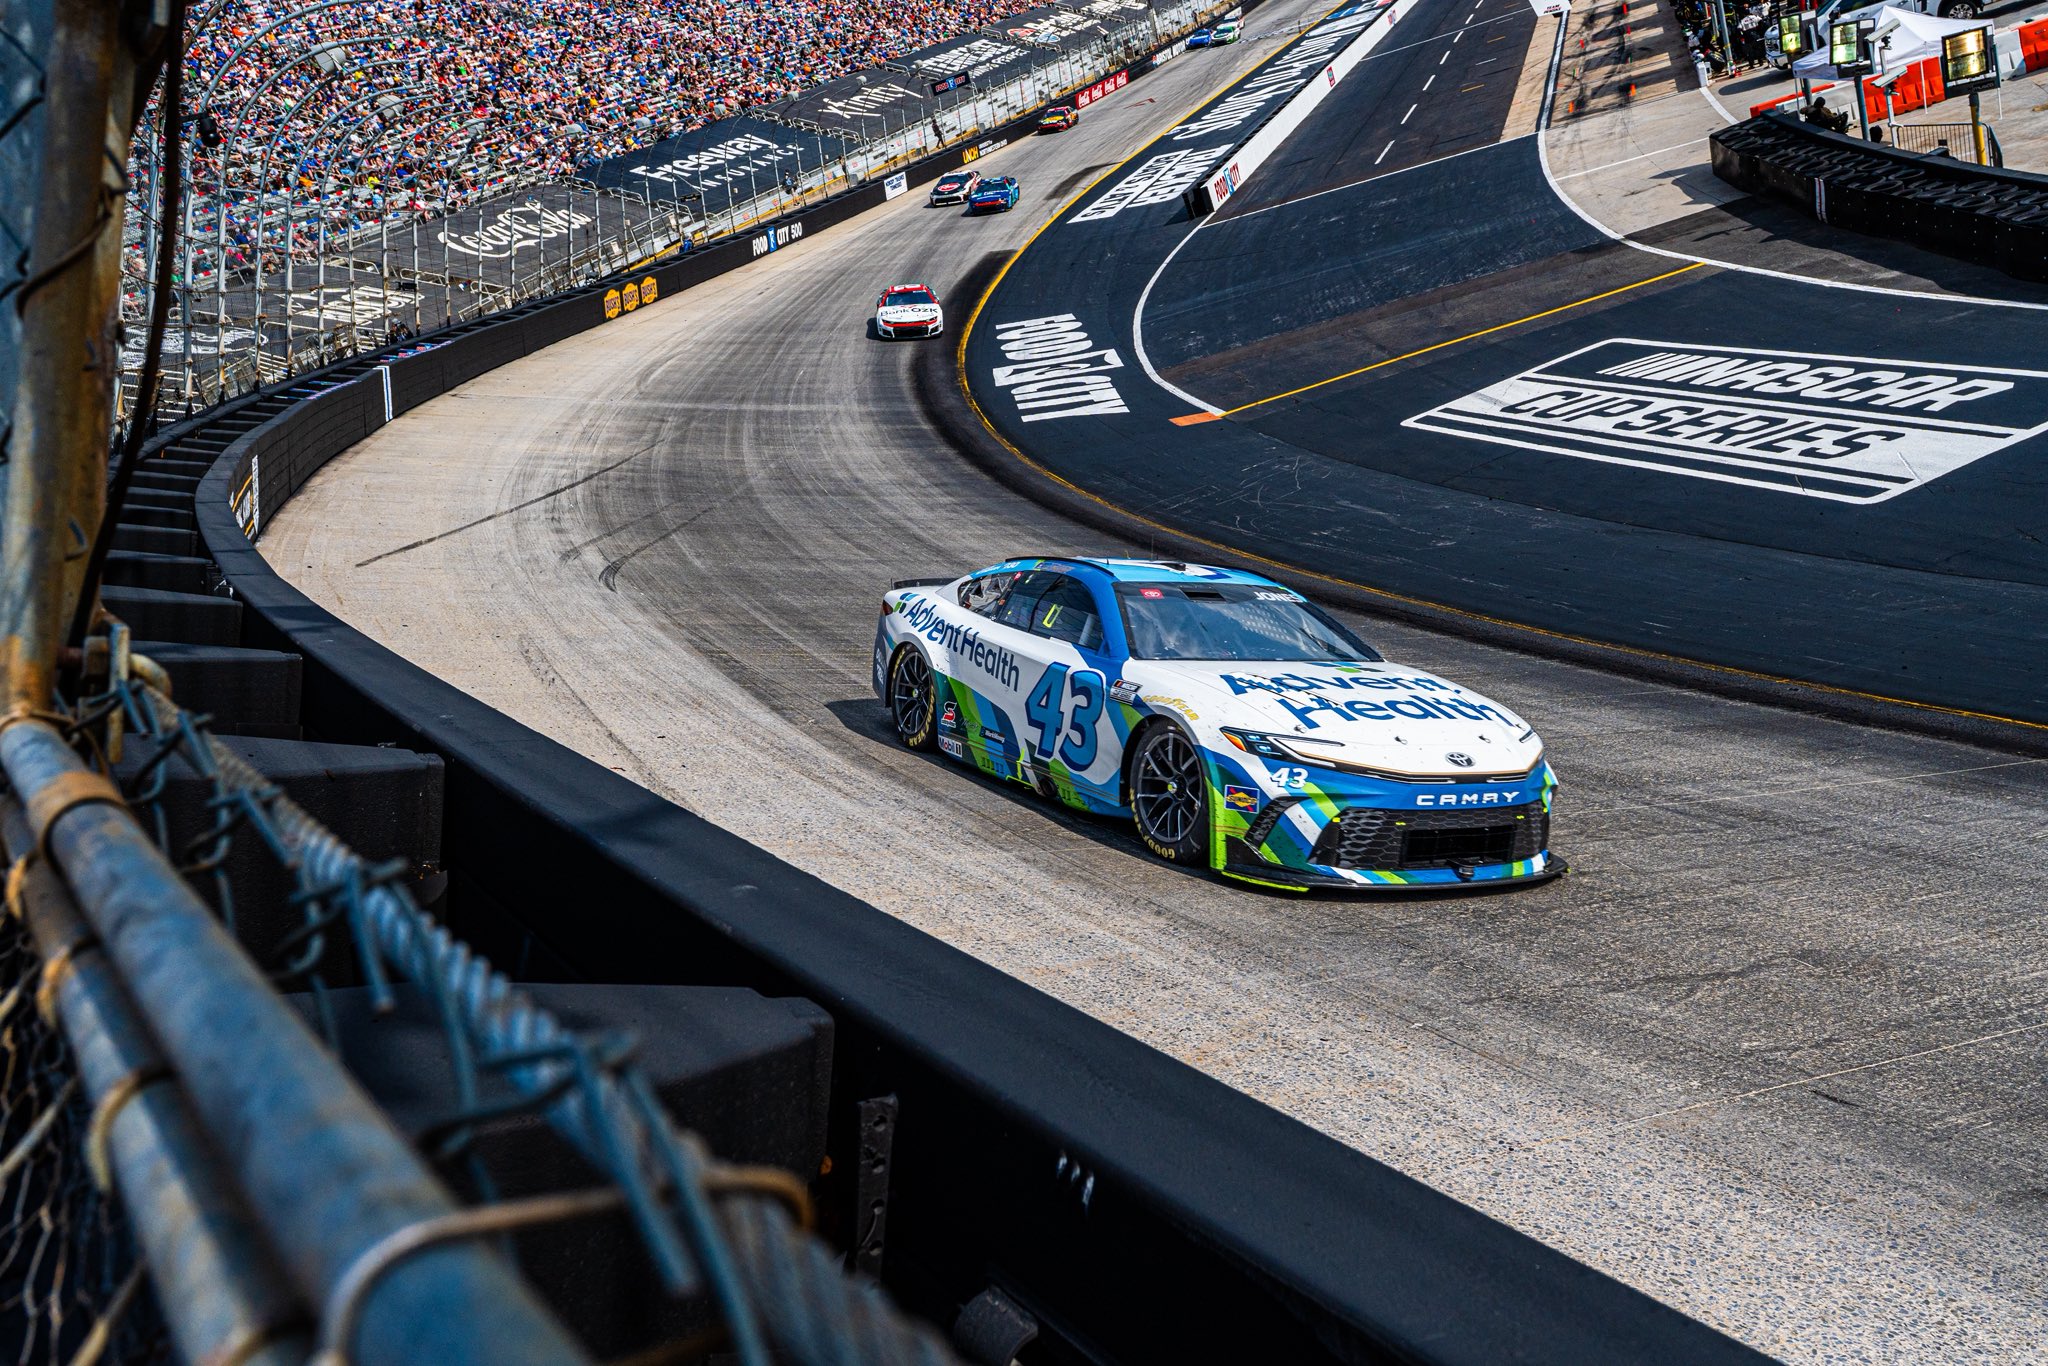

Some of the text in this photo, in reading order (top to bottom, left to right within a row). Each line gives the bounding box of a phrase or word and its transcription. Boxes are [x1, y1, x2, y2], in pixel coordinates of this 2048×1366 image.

[629, 134, 779, 182] Freeway
[1214, 162, 1241, 202] FOOD CITY
[752, 221, 802, 256] FOOD CITY 500
[996, 313, 1093, 361] FOOD
[1011, 375, 1130, 423] CITY
[1664, 356, 2015, 413] NASCAR
[1254, 591, 1303, 603] JONES
[904, 597, 1020, 692] AdventHealth
[1025, 661, 1106, 772] 43
[1274, 694, 1517, 729] Health
[1268, 767, 1309, 789] 43
[1416, 791, 1520, 806] CAMRY
